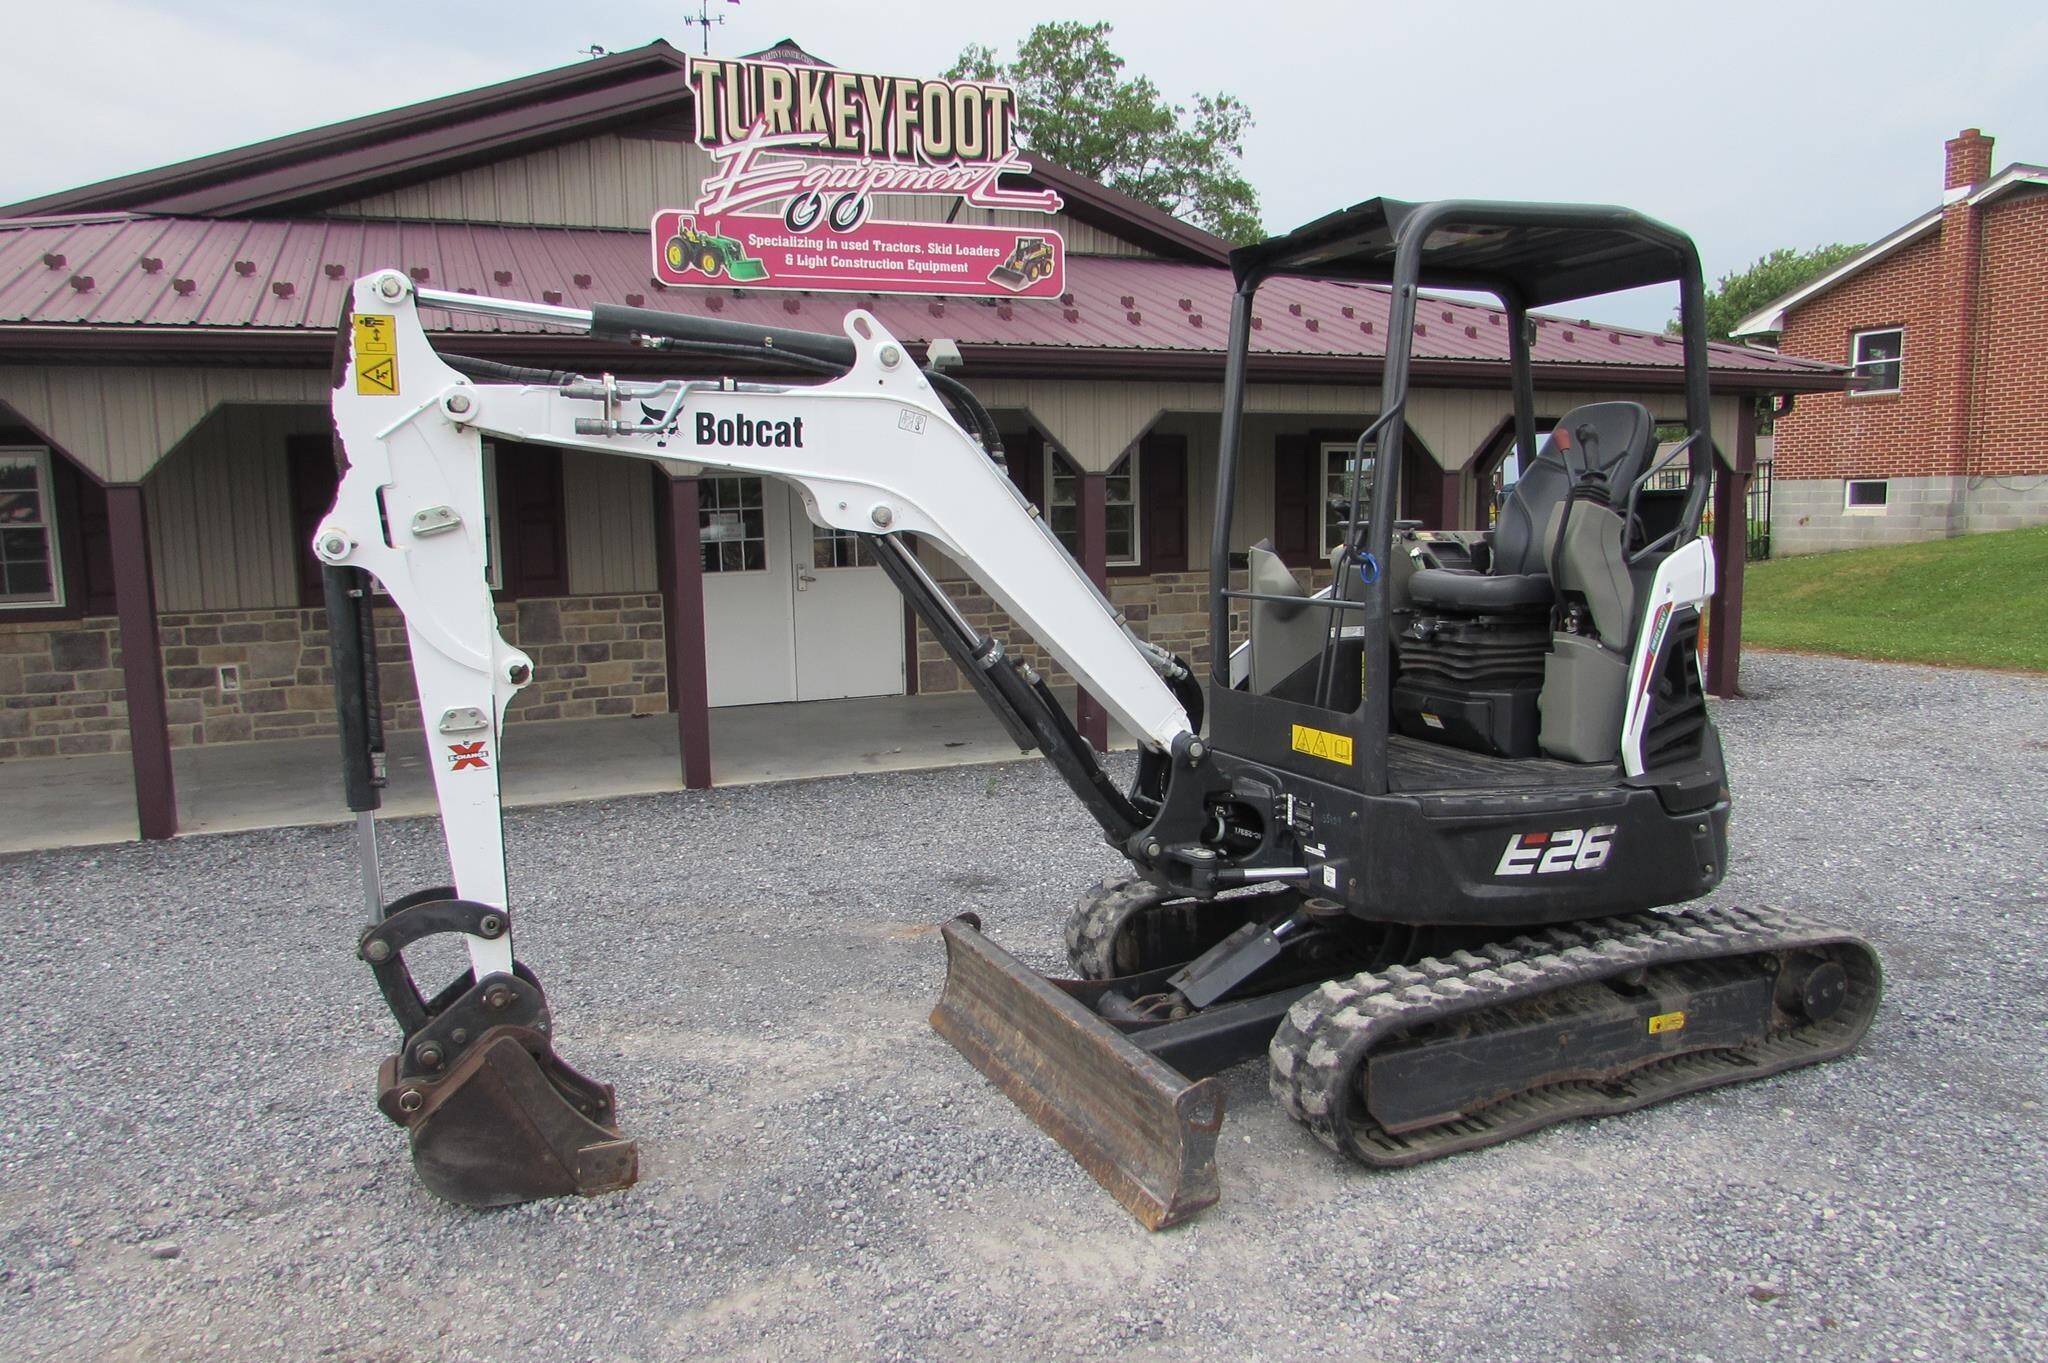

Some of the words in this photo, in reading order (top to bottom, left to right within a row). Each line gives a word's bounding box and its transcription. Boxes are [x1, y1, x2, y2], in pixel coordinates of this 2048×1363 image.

[691, 60, 1012, 161] TURKEYFOOT
[703, 118, 1060, 216] Equipment
[748, 233, 823, 251] Specializing
[826, 238, 838, 250] in
[840, 240, 869, 251] used
[872, 240, 925, 255] Tractors,
[928, 242, 953, 255] Skid
[955, 244, 1000, 257] Loaders
[785, 254, 793, 266] &
[796, 254, 828, 269] Light
[831, 256, 904, 271] Construction
[907, 259, 968, 274] Equipment
[695, 412, 803, 448] Bobcat
[1494, 824, 1617, 876] E26
